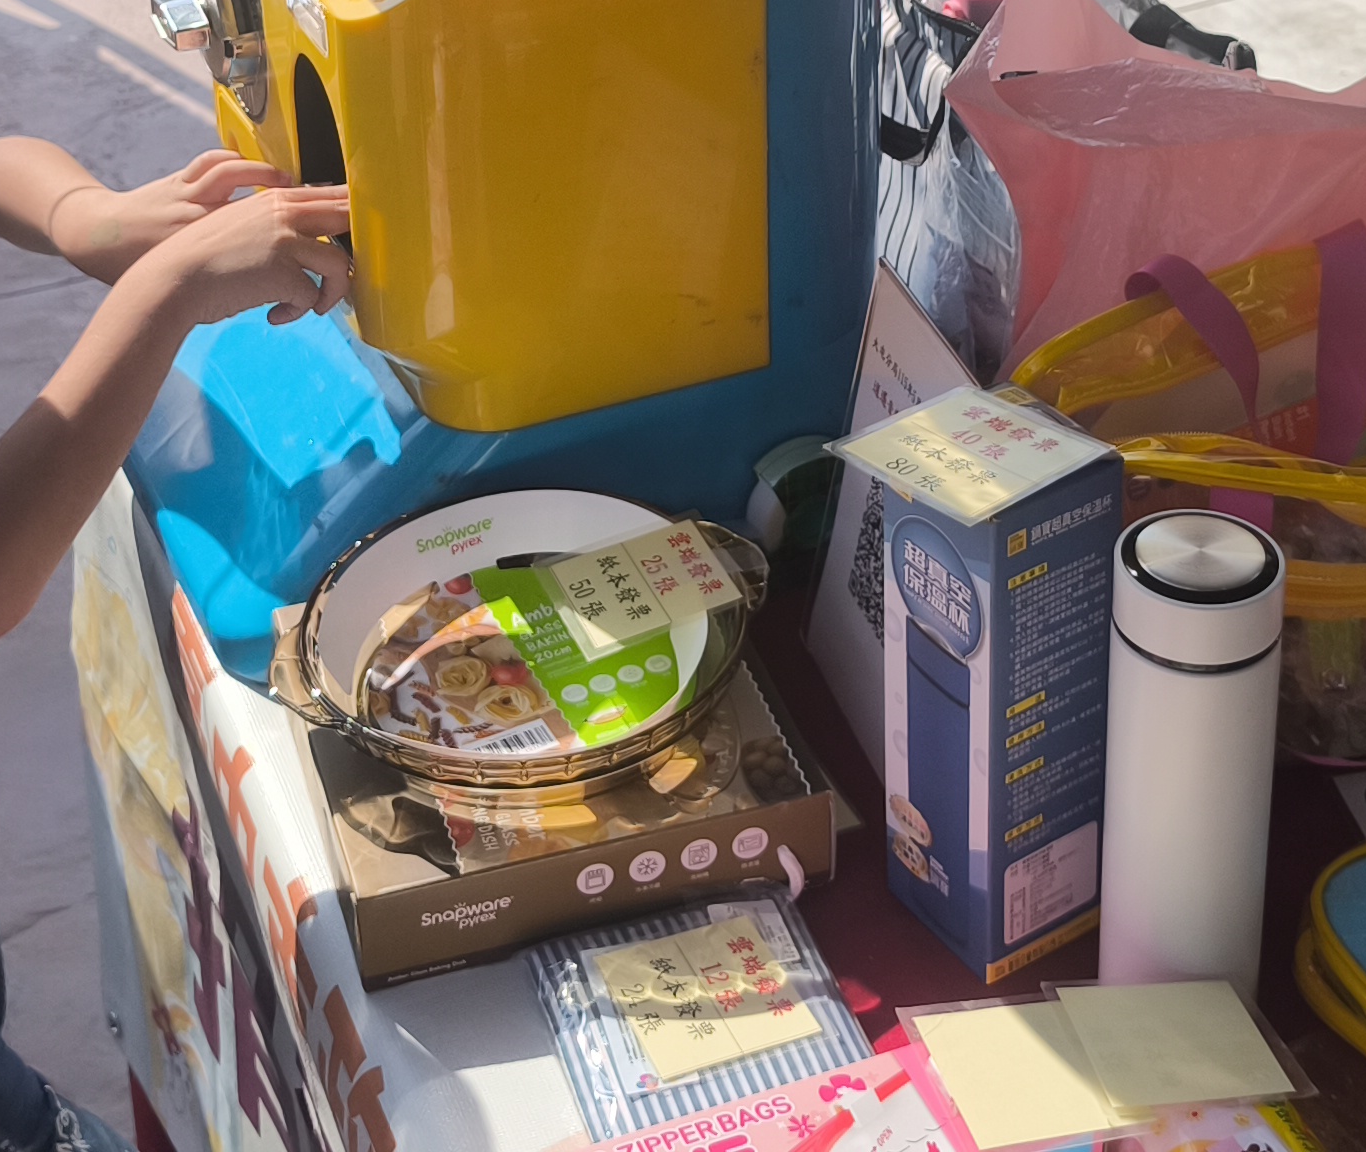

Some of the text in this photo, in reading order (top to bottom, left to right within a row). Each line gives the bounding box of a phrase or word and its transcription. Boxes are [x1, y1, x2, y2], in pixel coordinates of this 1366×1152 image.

[961, 405, 1060, 453] 雲端發票
[898, 434, 998, 485] 紙本發票
[416, 517, 494, 555] Snapware
[450, 535, 484, 556] pyrex
[596, 555, 655, 622] 紙本發票
[666, 532, 725, 597] 雲端發票
[904, 539, 972, 610] 超真空
[903, 563, 970, 635] 保溫杯
[525, 631, 570, 653] BAKIN
[421, 893, 514, 929] Snapware
[458, 910, 498, 930] pyrex
[650, 957, 717, 1041] 紙本發票
[726, 934, 796, 1017] 雲端發票
[616, 1117, 720, 1152] ZIPPER
[716, 1094, 795, 1136] BAGS
